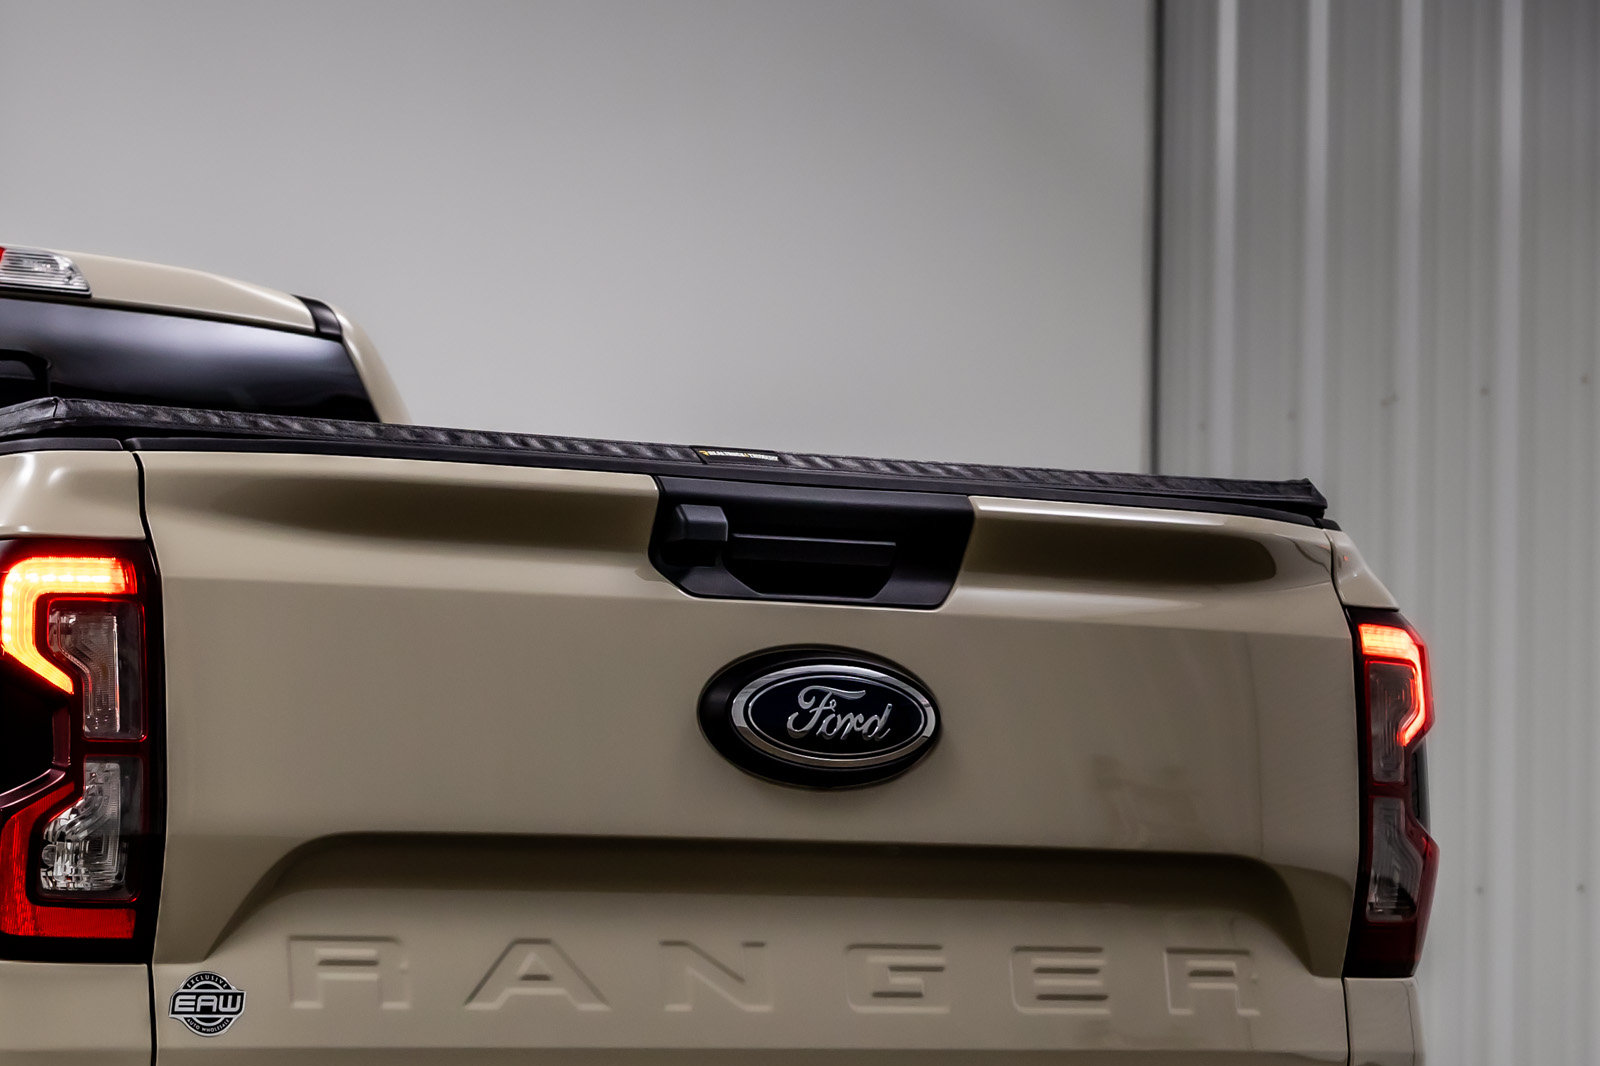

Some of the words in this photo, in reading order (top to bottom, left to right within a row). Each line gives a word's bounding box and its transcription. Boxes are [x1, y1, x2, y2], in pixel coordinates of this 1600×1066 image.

[786, 684, 894, 742] Ford
[187, 975, 228, 988] EXCLUSIVE
[287, 935, 1260, 1016] RANGER
[174, 995, 241, 1012] EAW
[187, 1018, 201, 1031] AUTO
